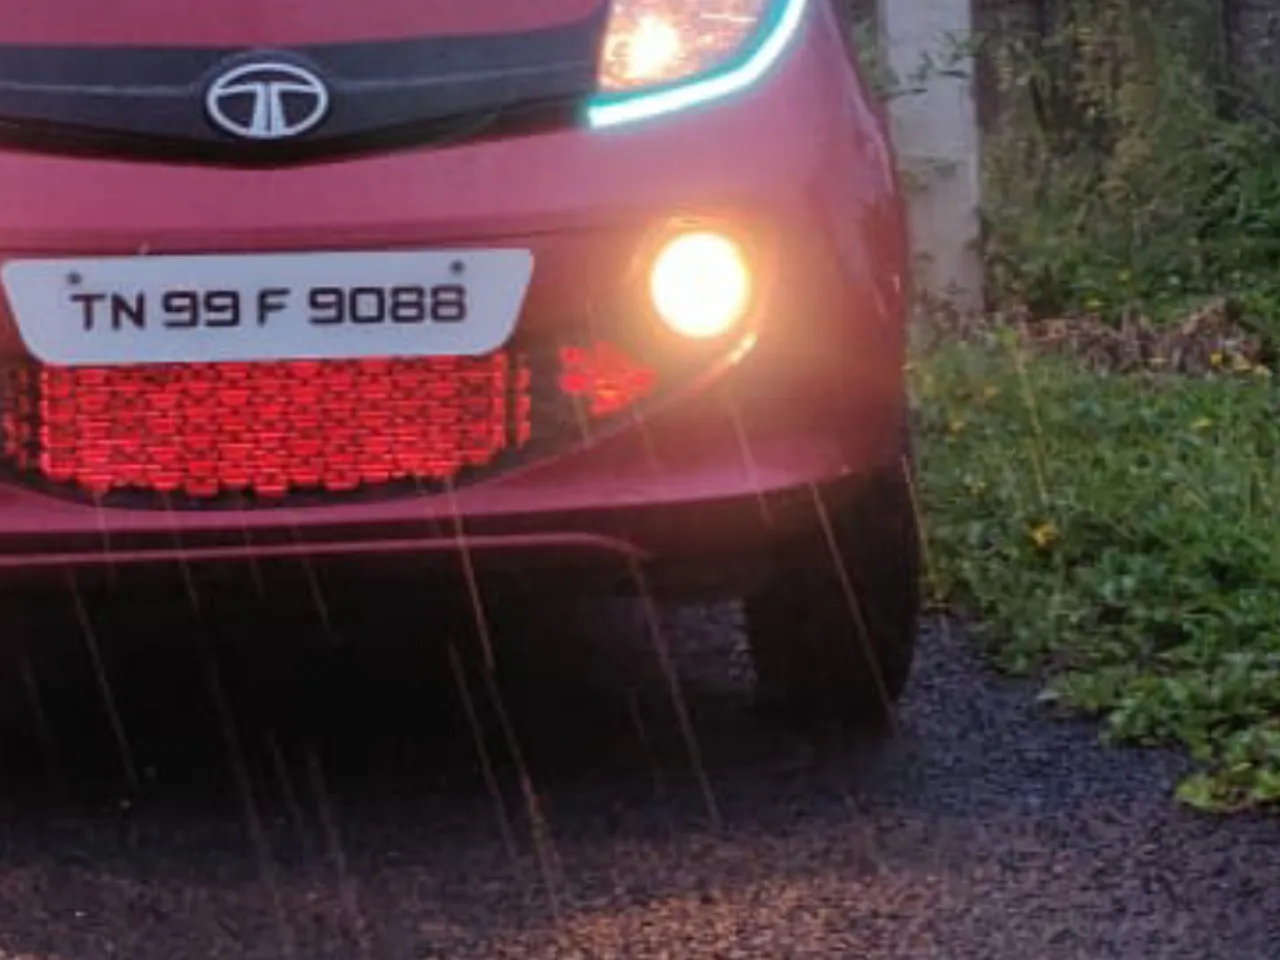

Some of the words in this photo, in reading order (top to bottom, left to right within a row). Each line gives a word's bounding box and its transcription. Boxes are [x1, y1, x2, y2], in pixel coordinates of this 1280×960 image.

[70, 292, 145, 331] TN
[161, 290, 241, 328] 99
[256, 287, 291, 326] F
[307, 284, 467, 326] 9088
